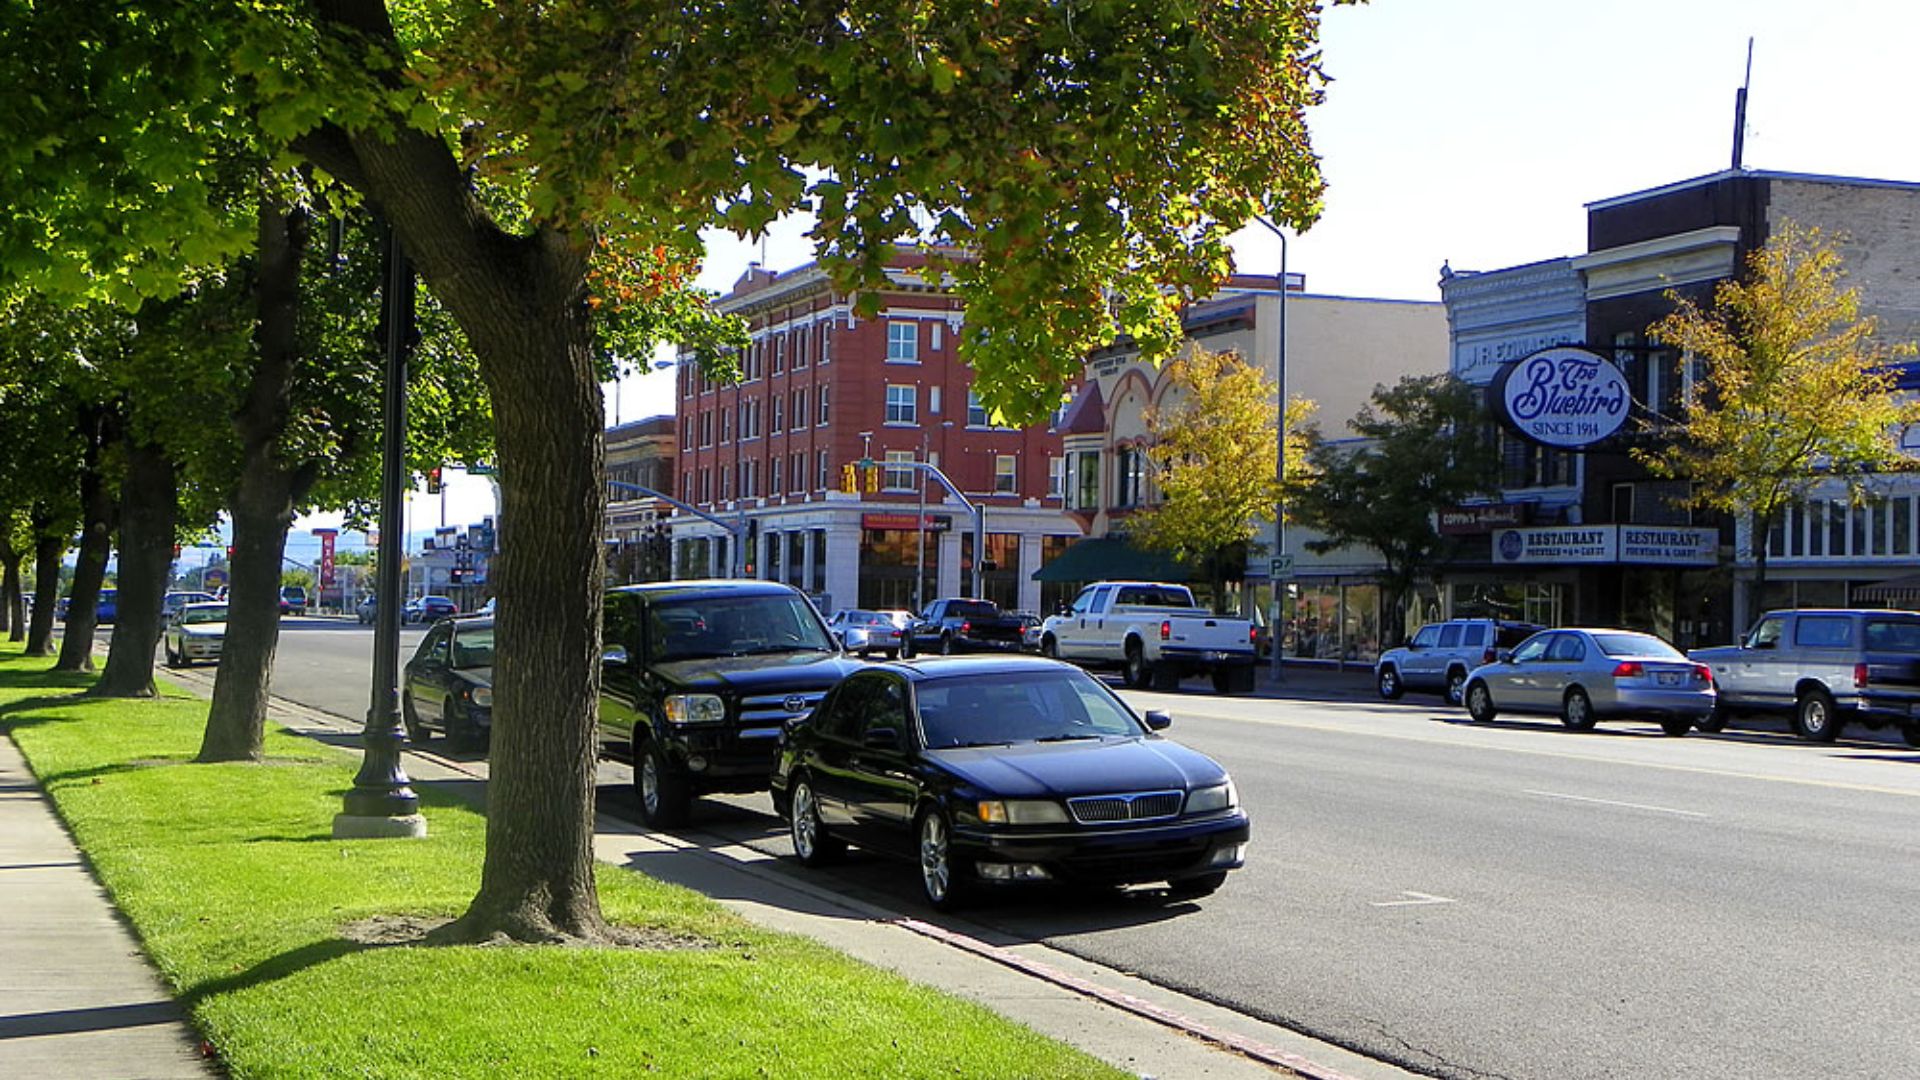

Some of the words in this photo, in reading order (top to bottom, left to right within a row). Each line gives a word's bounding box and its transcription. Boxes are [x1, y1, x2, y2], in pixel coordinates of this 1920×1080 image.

[1558, 358, 1602, 391] The
[1513, 358, 1623, 420] Bluebird
[1532, 422, 1573, 435] SINCE
[1577, 421, 1599, 436] 1914
[1528, 531, 1604, 546] RESTAURANT
[1626, 531, 1700, 546] RESTAURANT
[1271, 559, 1283, 575] P
